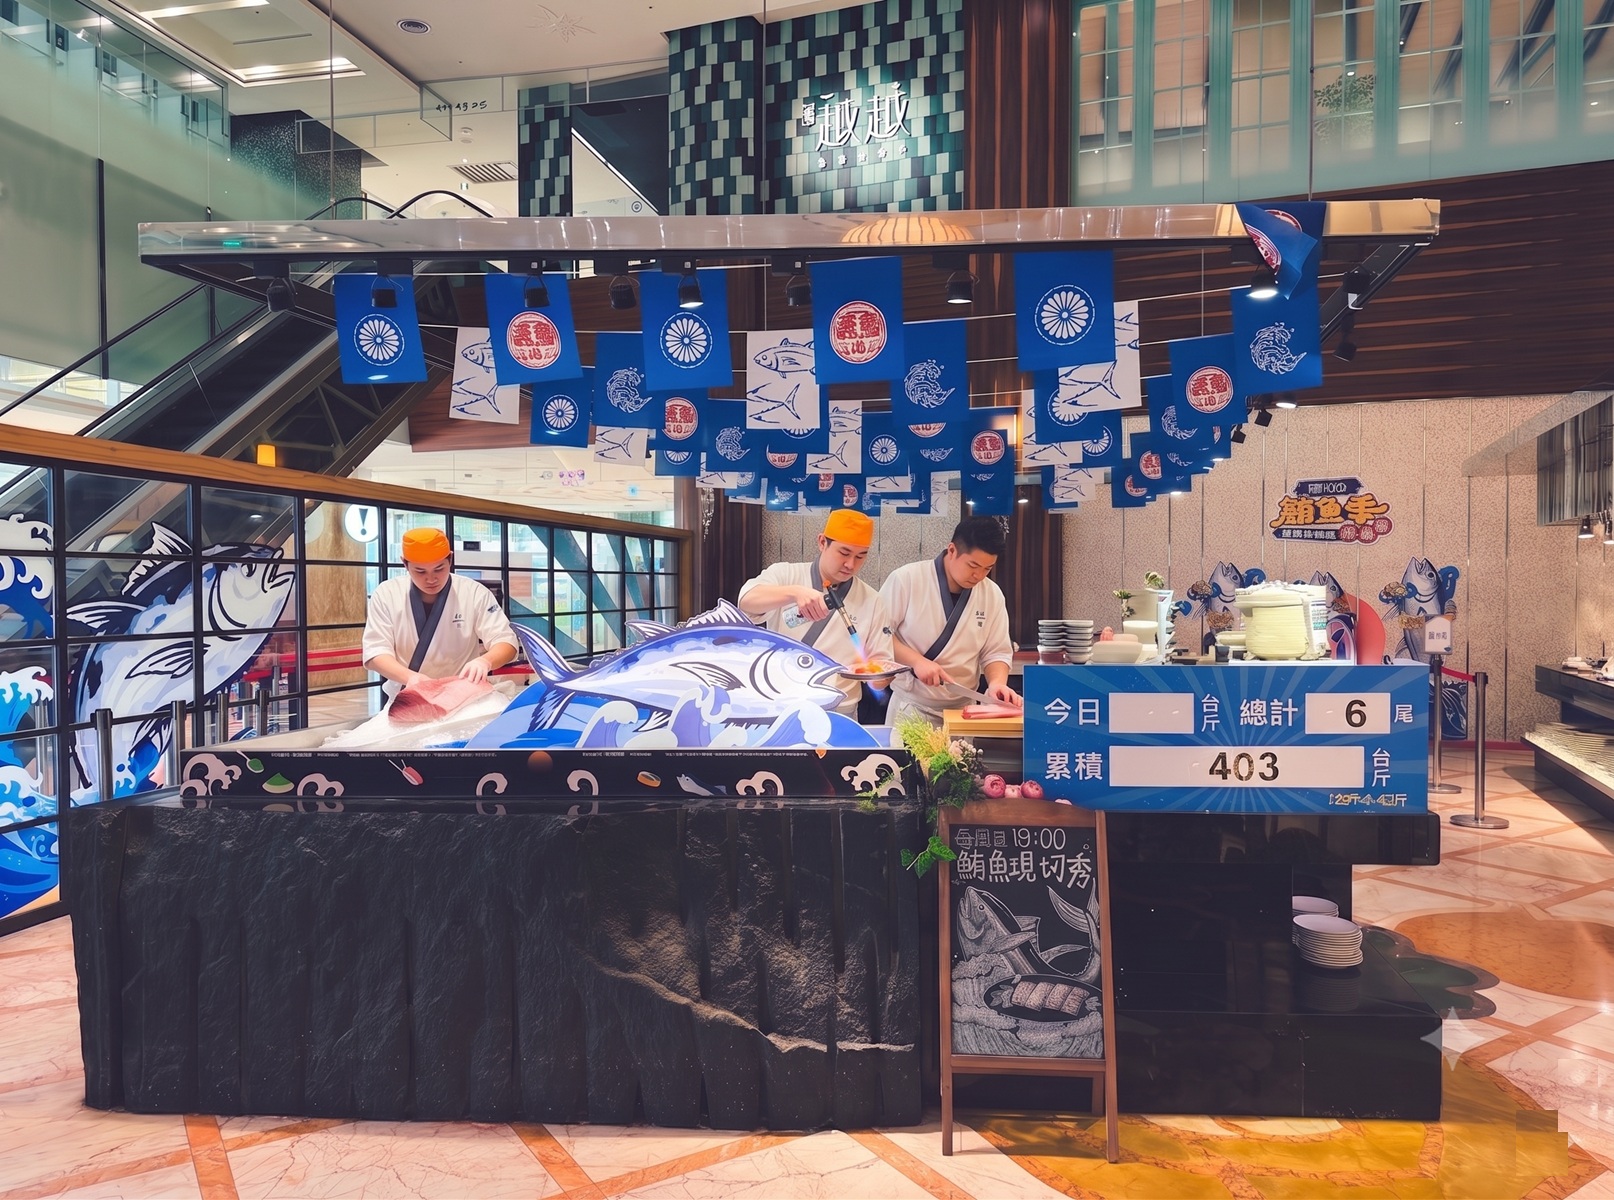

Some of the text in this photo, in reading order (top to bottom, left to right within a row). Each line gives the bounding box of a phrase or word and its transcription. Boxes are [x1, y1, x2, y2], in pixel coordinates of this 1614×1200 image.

[1044, 694, 1414, 732] 今日 台斤 總計 6 尾
[1045, 747, 1391, 787] 累積 403 台斤
[1012, 827, 1066, 851] 19:00
[957, 848, 1092, 889] 鮪魚現切秀
